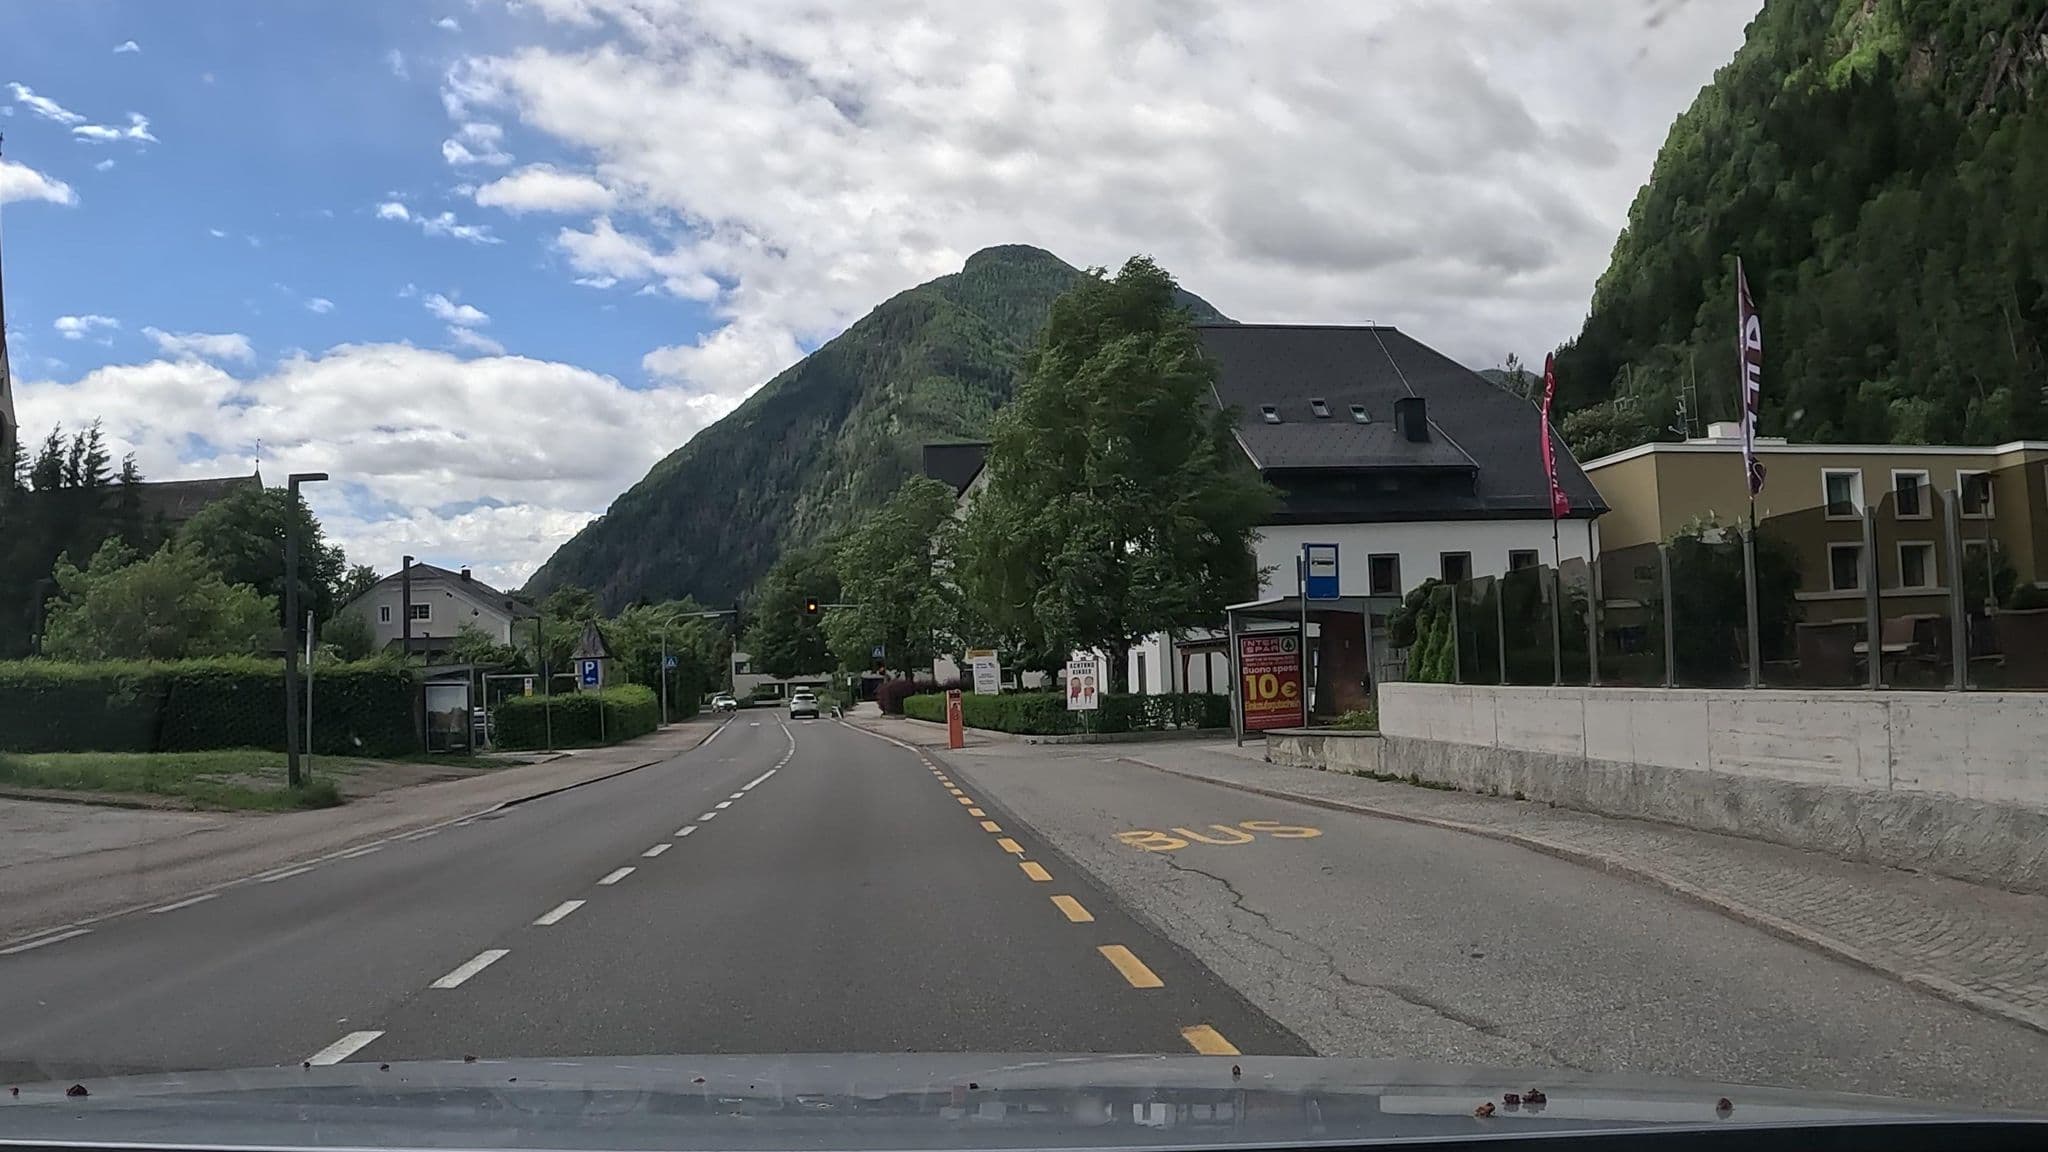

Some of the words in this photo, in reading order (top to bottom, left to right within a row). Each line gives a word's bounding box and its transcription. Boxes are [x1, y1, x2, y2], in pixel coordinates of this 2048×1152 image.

[1243, 638, 1279, 648] INTER
[1246, 646, 1279, 654] SPAR
[585, 661, 595, 675] P
[1242, 666, 1271, 675] Buono
[1112, 820, 1323, 851] BUS
